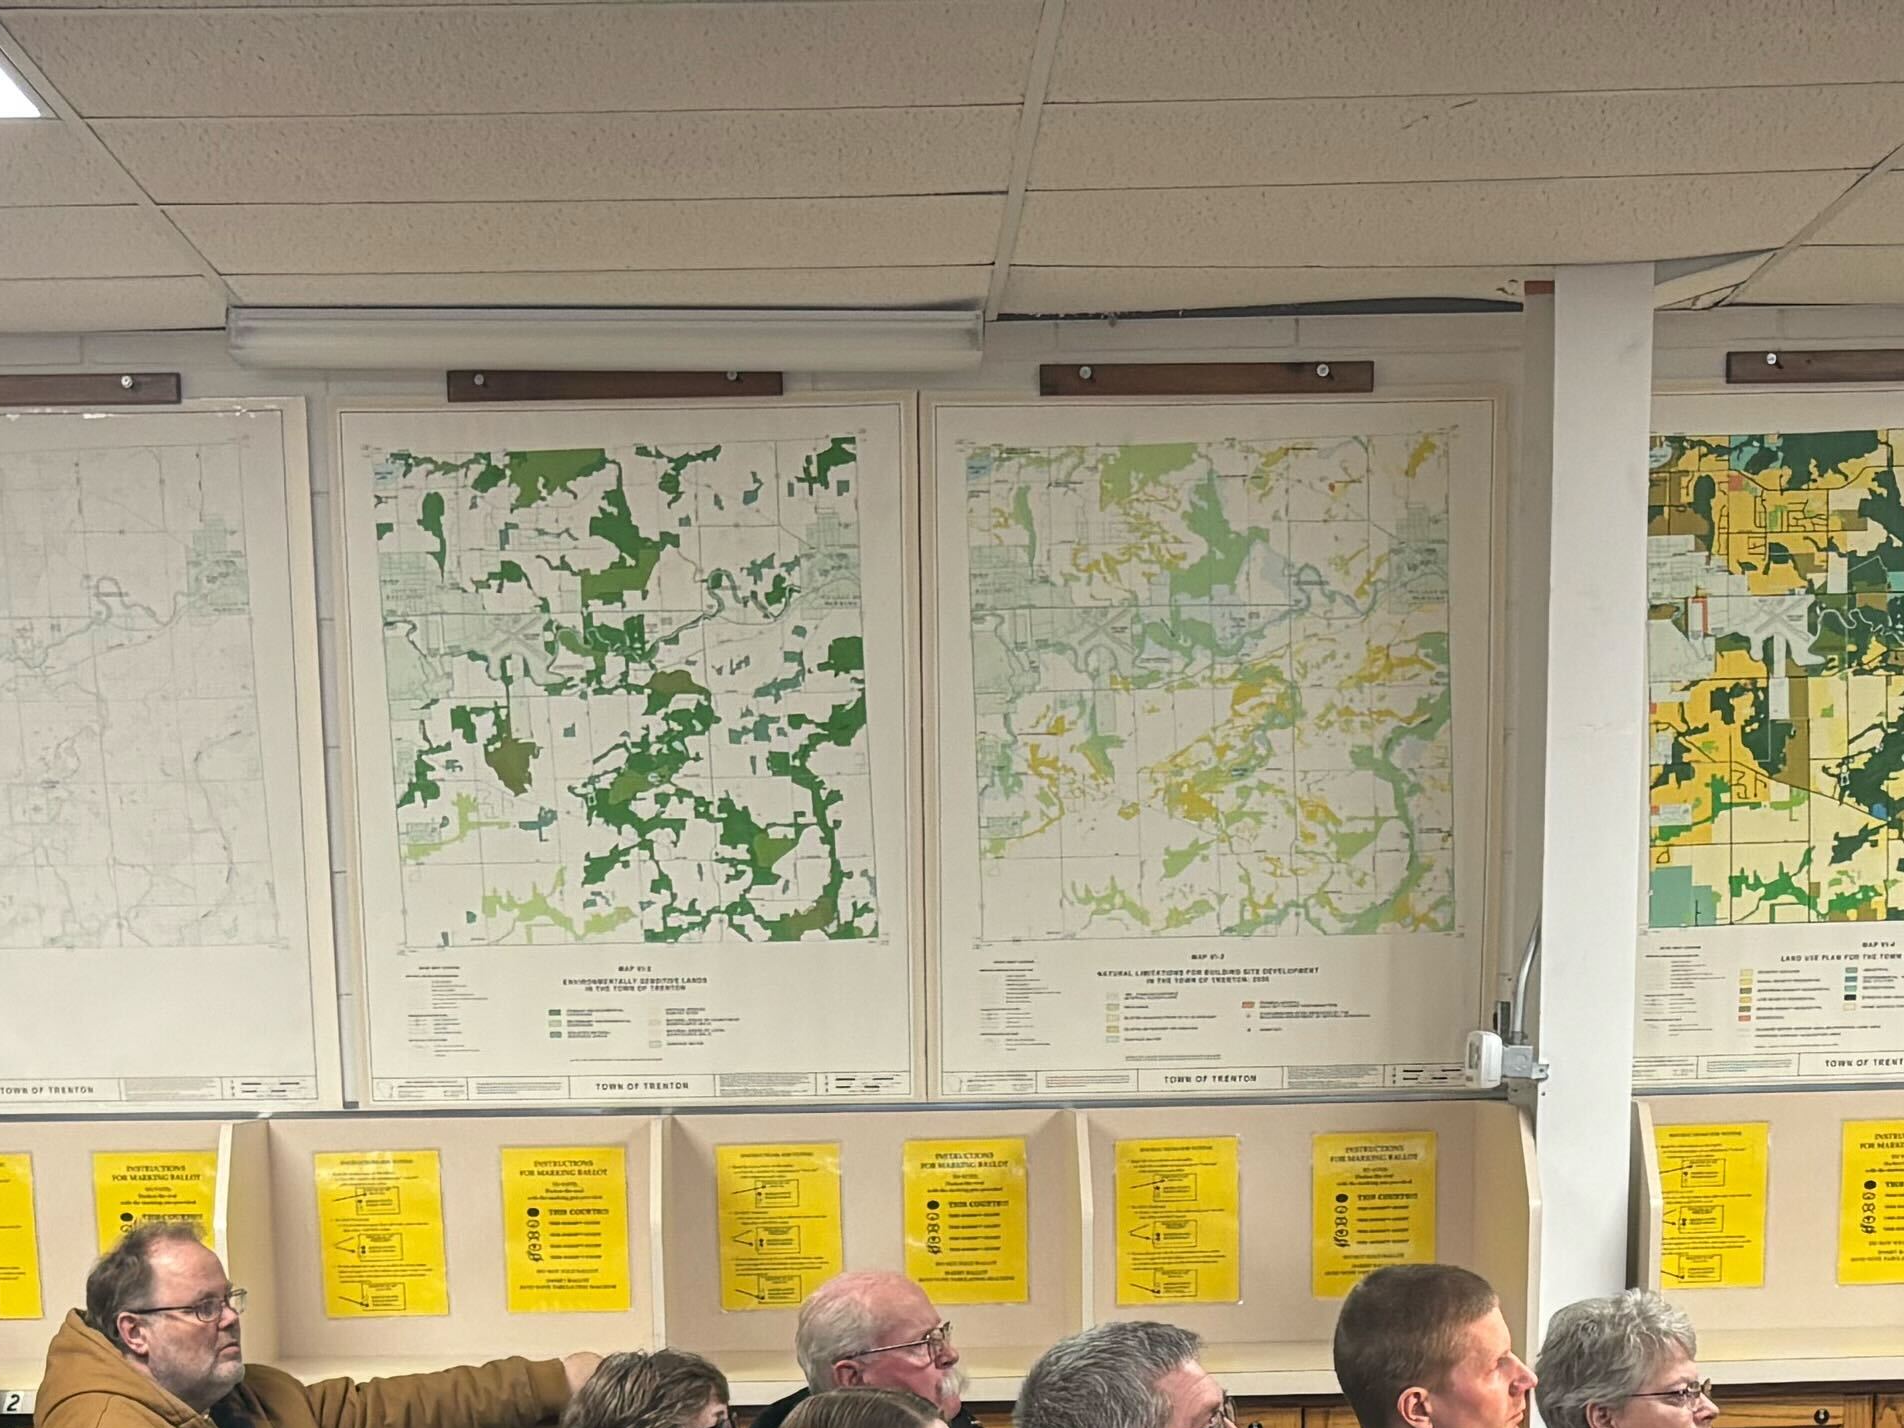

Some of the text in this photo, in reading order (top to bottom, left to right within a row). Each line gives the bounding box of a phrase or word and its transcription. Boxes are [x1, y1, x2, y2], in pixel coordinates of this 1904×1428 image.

[1825, 1059, 1853, 1067] TOWN
[1164, 1076, 1192, 1084] TOWN
[1195, 1075, 1207, 1083] OF
[48, 1086, 94, 1094] TRENTON
[644, 1082, 689, 1090] TRENTON
